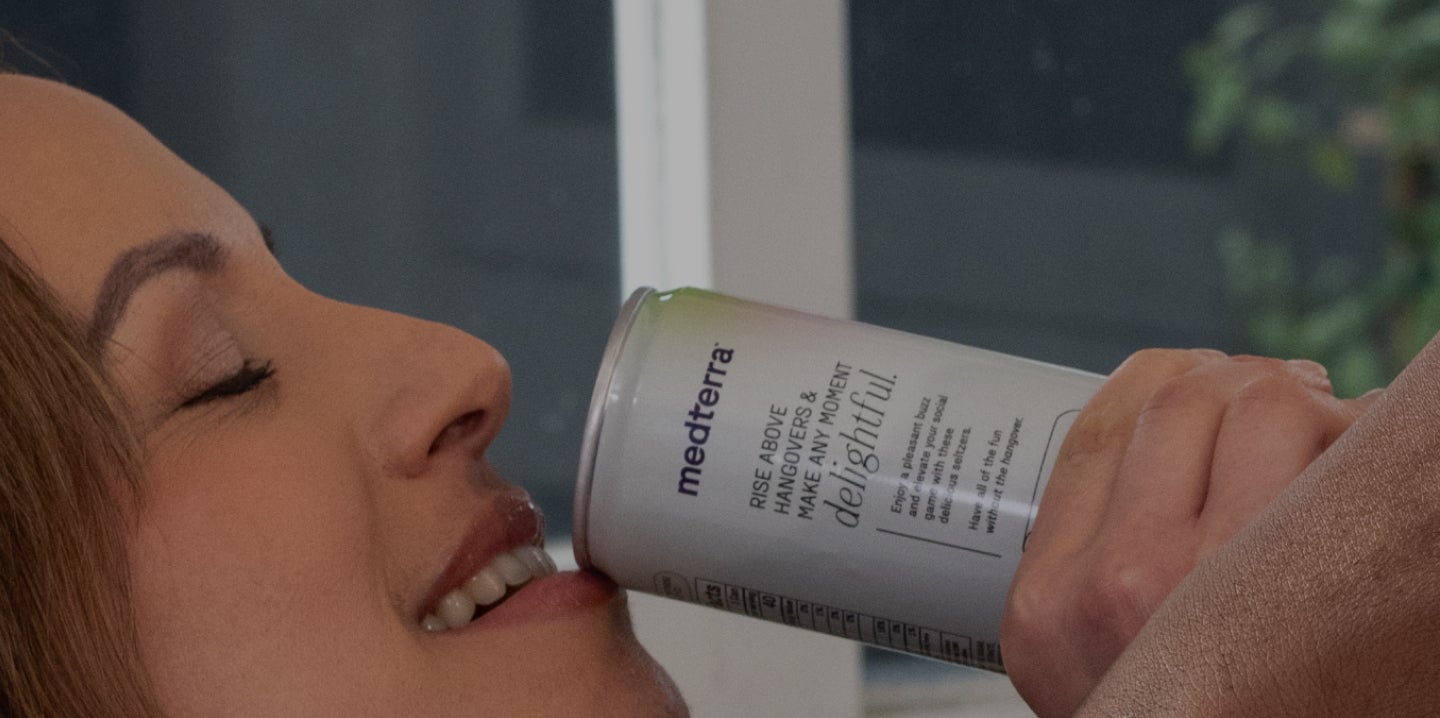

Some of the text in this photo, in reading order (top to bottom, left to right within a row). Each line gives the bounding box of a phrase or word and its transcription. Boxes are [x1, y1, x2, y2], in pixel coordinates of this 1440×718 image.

[678, 348, 734, 496] medterra
[750, 404, 787, 509] RISE ABOVE
[774, 391, 818, 515] HANGOVERS &
[798, 361, 852, 520] MAKE ANY MOMENT
[823, 369, 898, 528] delightful.
[891, 397, 931, 514] Enjoy a pleasant buzz
[909, 394, 949, 517] and elevate your social
[924, 428, 954, 521] game with these
[938, 427, 972, 524] delicous seltzers.
[995, 467, 1008, 486] the
[1000, 417, 1024, 466] hangover.
[968, 429, 1002, 530] Have all of the fun
